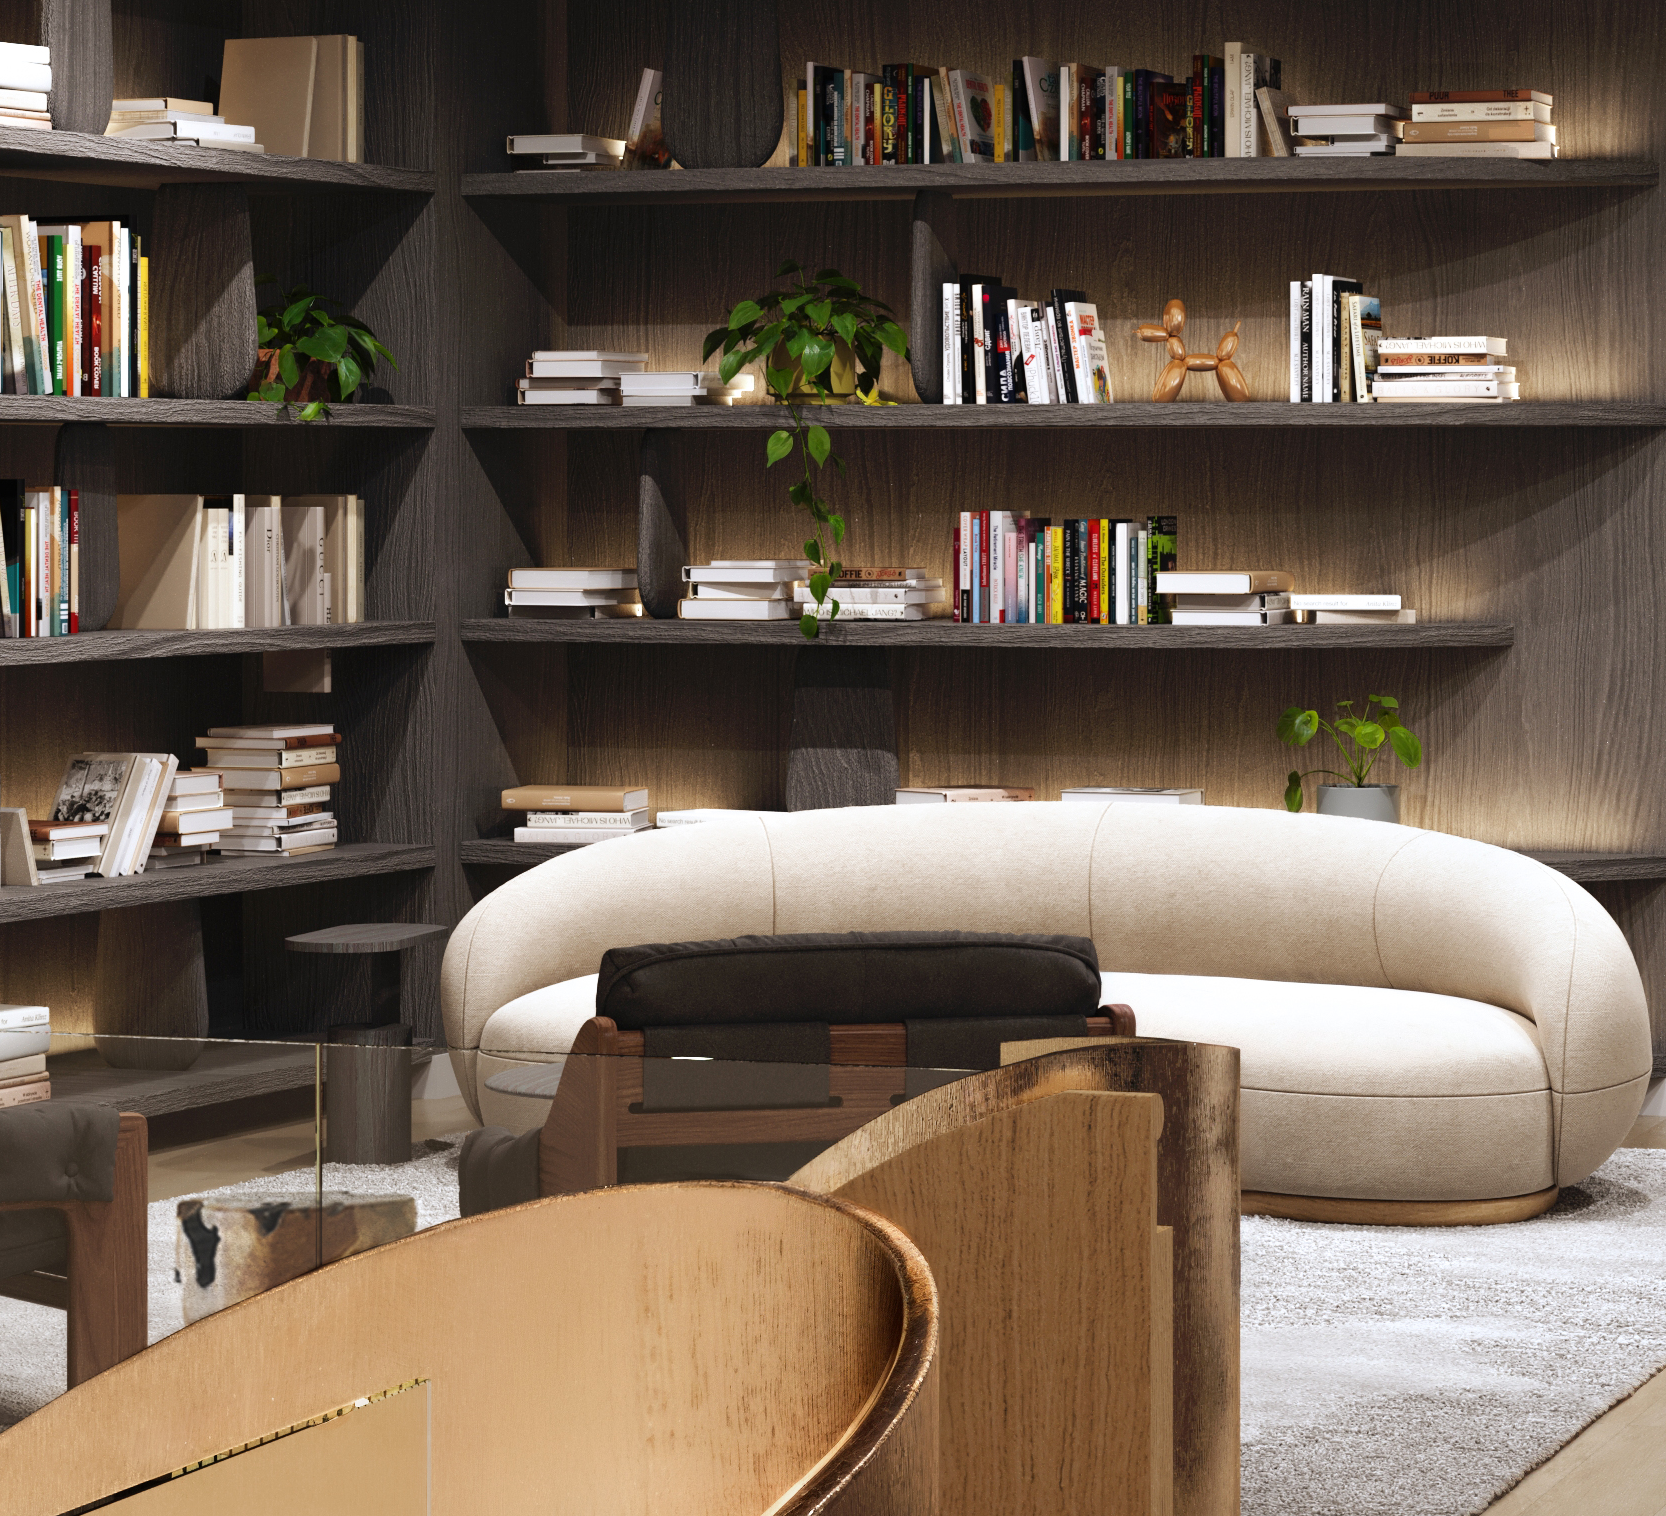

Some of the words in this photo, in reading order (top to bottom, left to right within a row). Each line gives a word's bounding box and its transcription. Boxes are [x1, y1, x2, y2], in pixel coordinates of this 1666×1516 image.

[1244, 61, 1252, 89] JANG?
[1428, 91, 1450, 101] PUUR
[1502, 89, 1519, 99] THEE
[1244, 90, 1252, 128] MICHAEL
[1244, 130, 1252, 138] IS
[7, 265, 19, 298] AFTER
[1302, 287, 1310, 309] RAIN
[10, 301, 21, 328] DAYS
[1021, 311, 1029, 330] ВИКТОР
[1302, 310, 1310, 333] MAN
[1351, 301, 1359, 321] SAFARI
[1023, 331, 1032, 353] ПЕЛЕВИН
[1068, 320, 1077, 344] ЗВОНКА
[1353, 331, 1361, 357] LIFETIME
[1072, 345, 1081, 369] МАСТЕР
[1427, 355, 1460, 365] KOFFIE
[1079, 579, 1087, 604] MAGIC
[534, 816, 560, 825] JANG?
[562, 816, 598, 825] MICHAEL
[599, 816, 607, 825] IS
[608, 816, 631, 825] WHO
